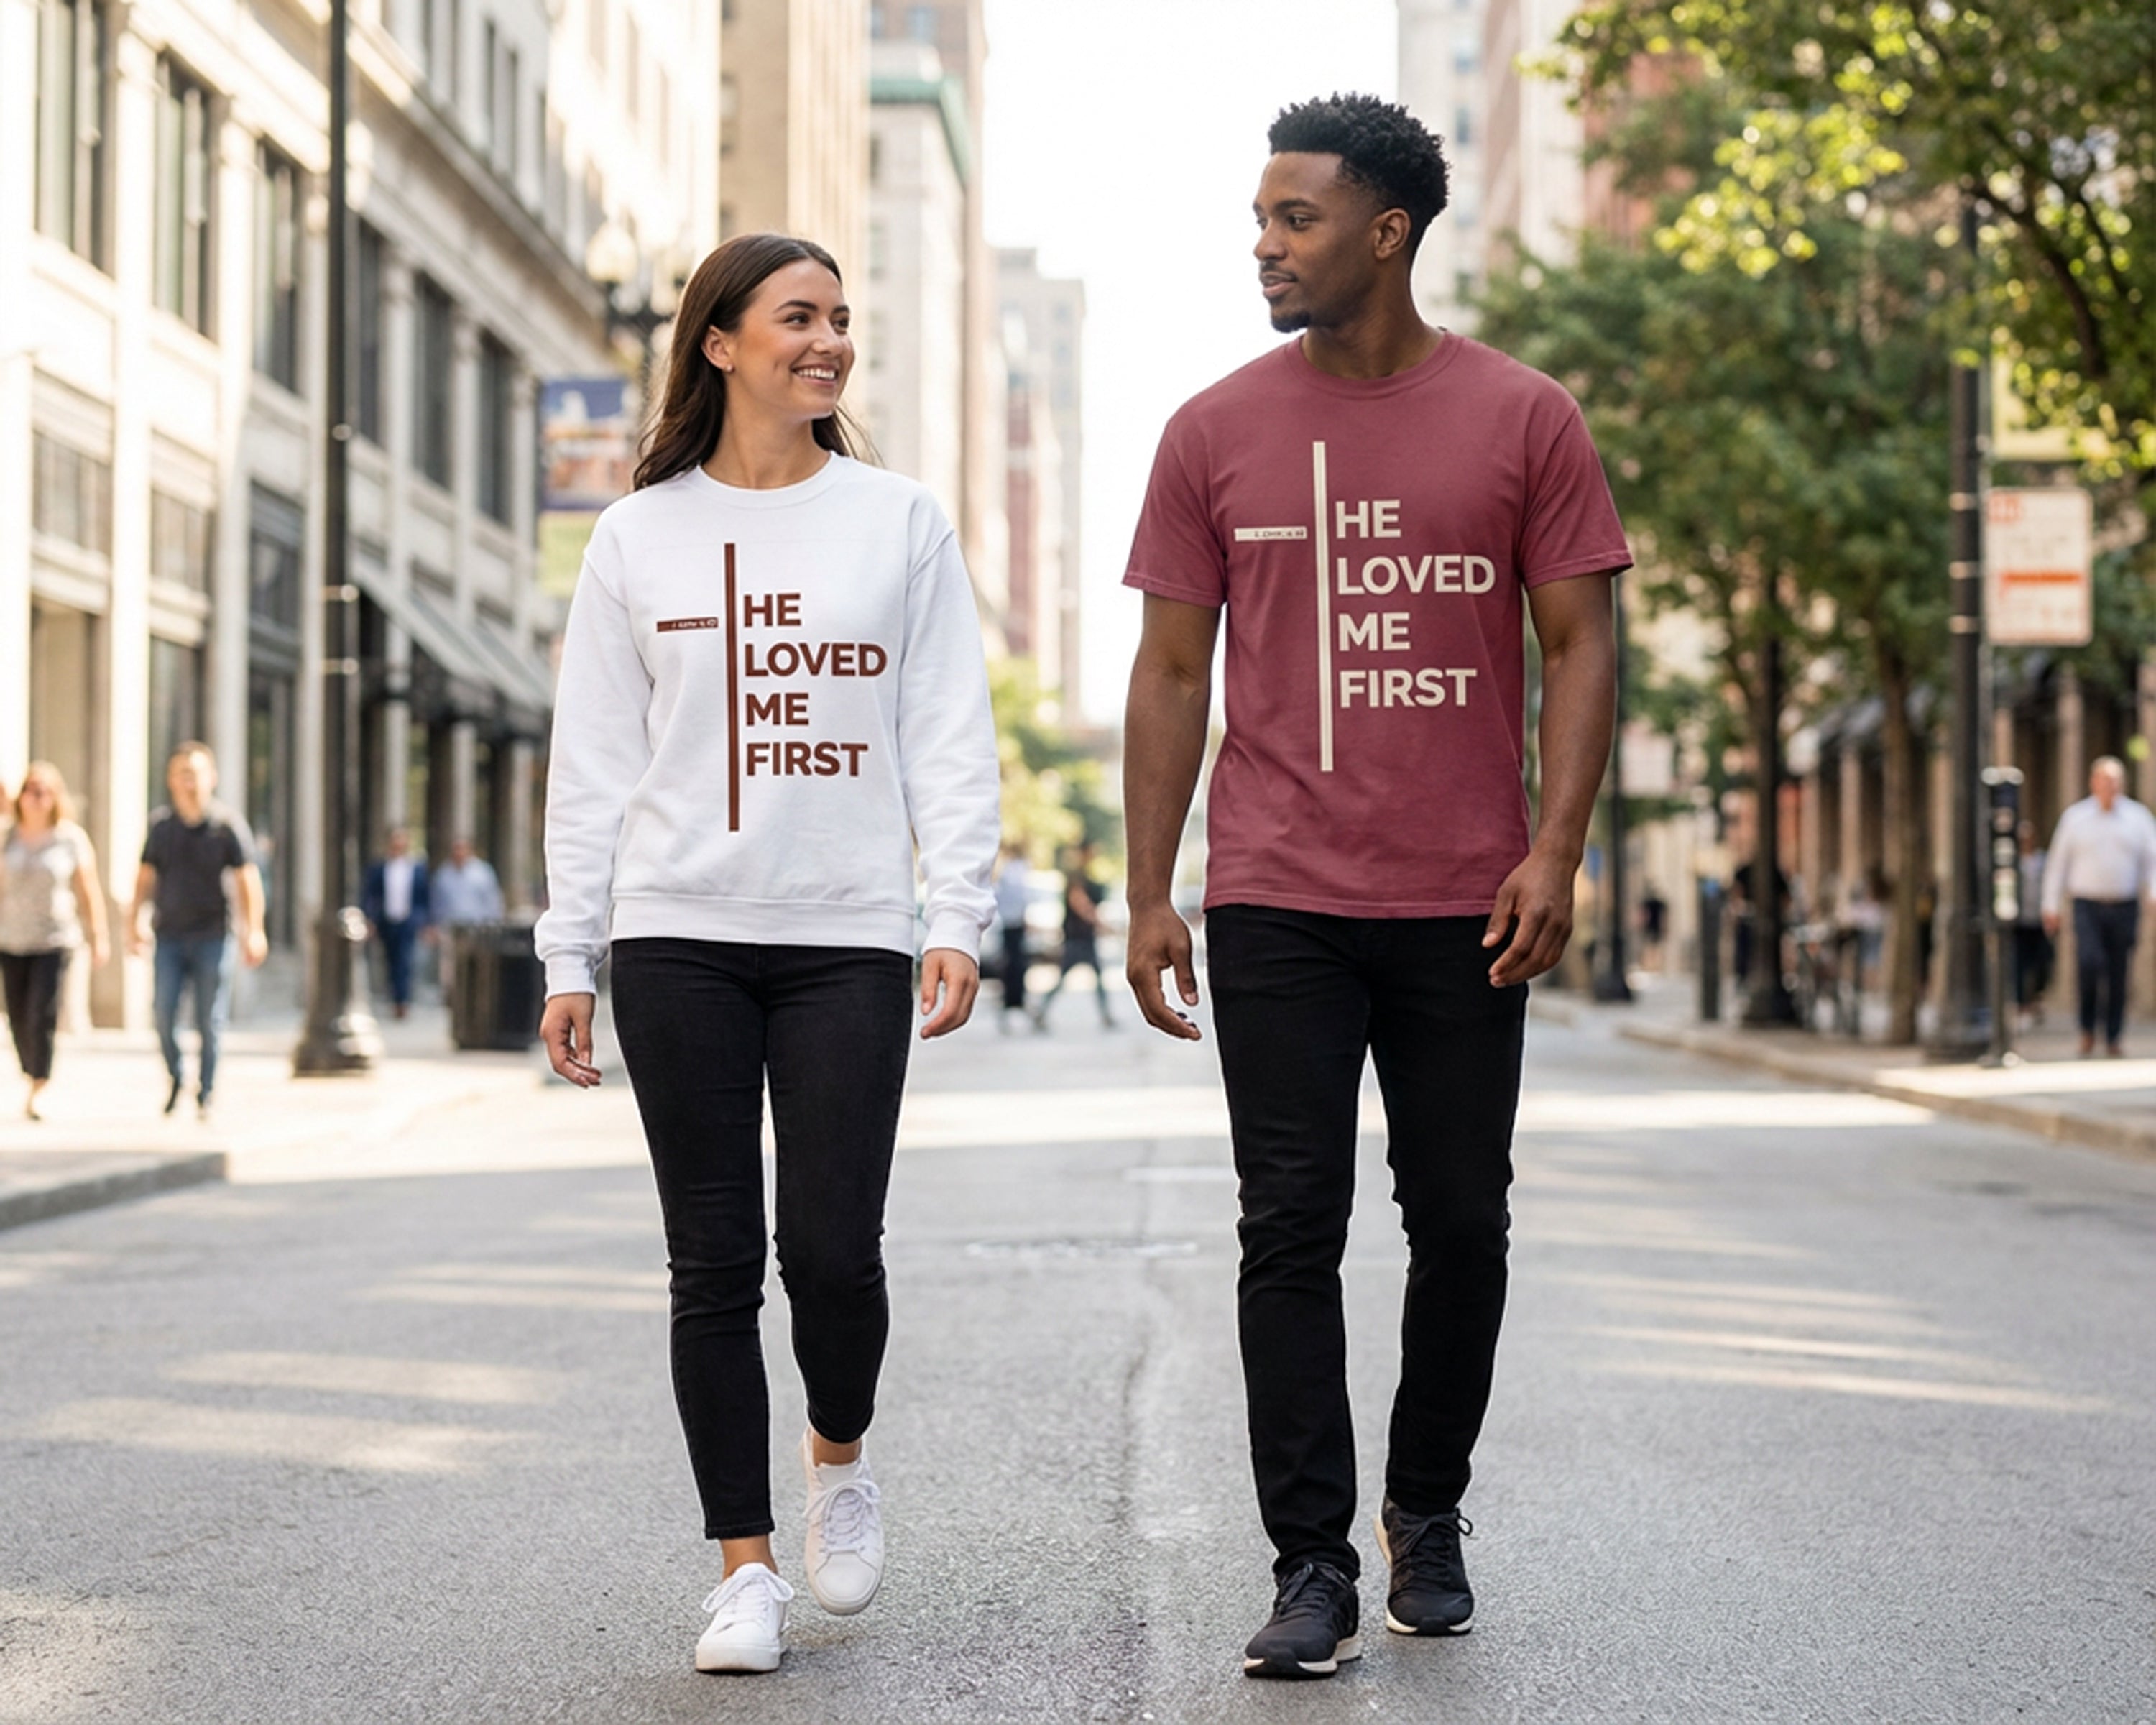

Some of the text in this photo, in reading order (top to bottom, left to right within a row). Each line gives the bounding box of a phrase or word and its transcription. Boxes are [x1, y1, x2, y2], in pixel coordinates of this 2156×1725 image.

[1335, 499, 1401, 538] HE
[1337, 554, 1496, 595] LOVED
[743, 593, 801, 627] HE
[1338, 612, 1411, 651] ME
[745, 643, 888, 677] LOVED
[1340, 668, 1478, 708] FIRST
[745, 692, 809, 727] ME
[746, 741, 869, 777] FIRST
